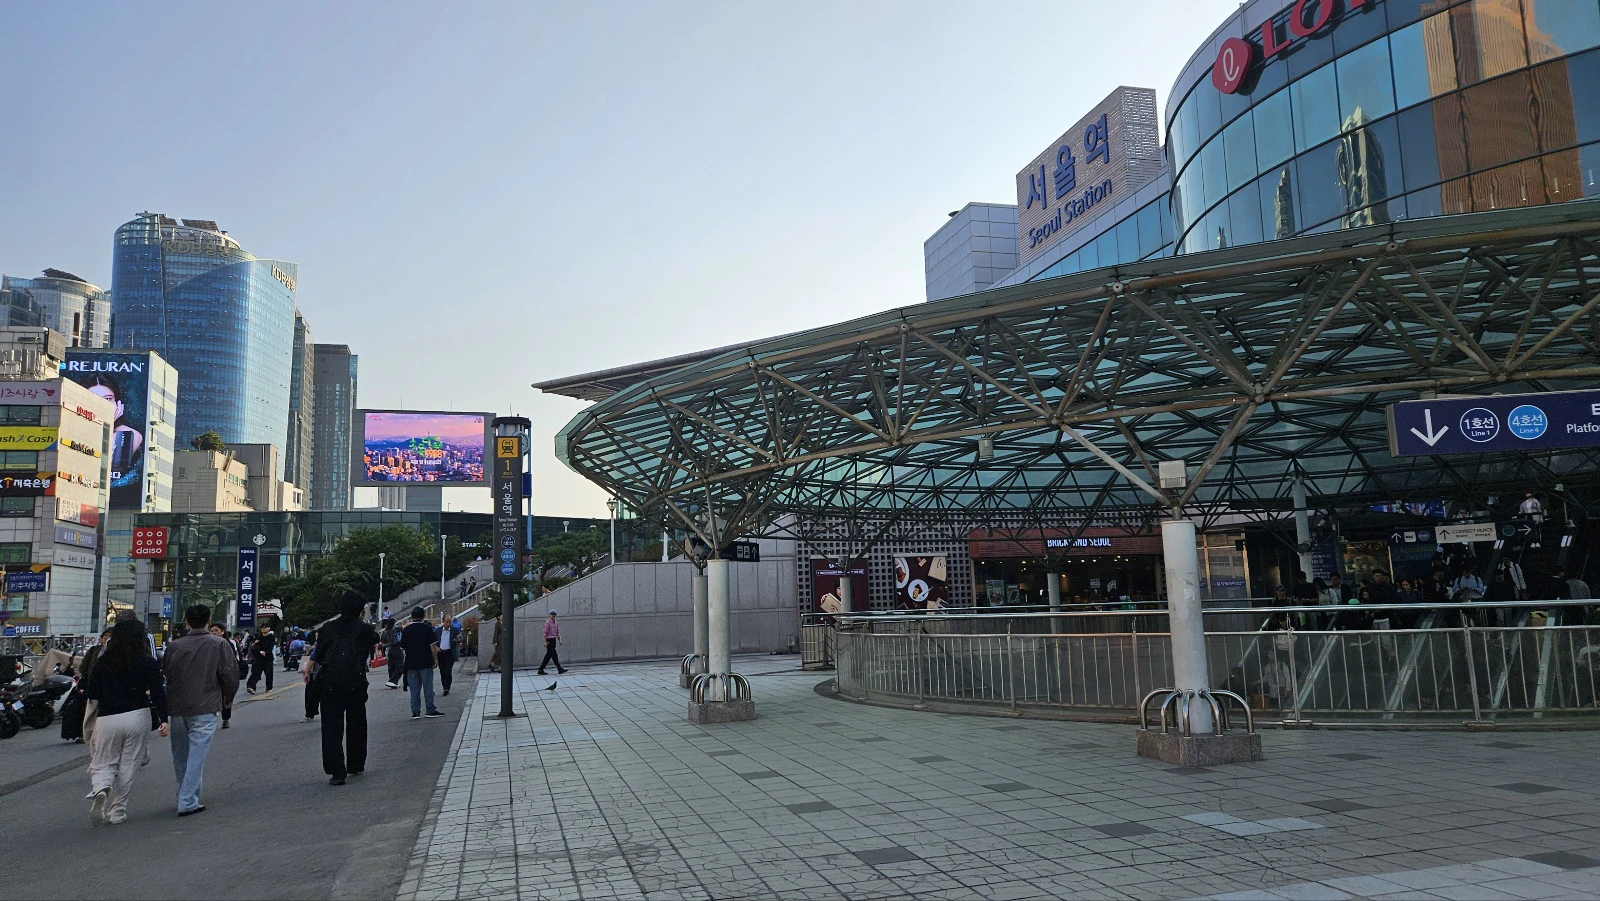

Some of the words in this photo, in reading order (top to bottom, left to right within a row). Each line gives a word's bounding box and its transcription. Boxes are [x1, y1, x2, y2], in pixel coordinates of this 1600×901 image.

[1261, 0, 1367, 58] LO
[1026, 113, 1110, 210] 서울역
[1028, 208, 1062, 249] Seoul
[1064, 178, 1113, 225] Station
[69, 360, 143, 372] REJURAN
[1464, 416, 1495, 430] 1호선
[1512, 414, 1543, 427] 4호선
[1566, 422, 1600, 434] Platfo
[27, 435, 54, 443] Cash
[505, 460, 511, 471] 1
[13, 479, 51, 489] 저축은행
[502, 482, 513, 516] 서울역
[18, 581, 37, 590] 주차장
[241, 560, 253, 607] 서울역
[15, 625, 41, 633] COFFEE
